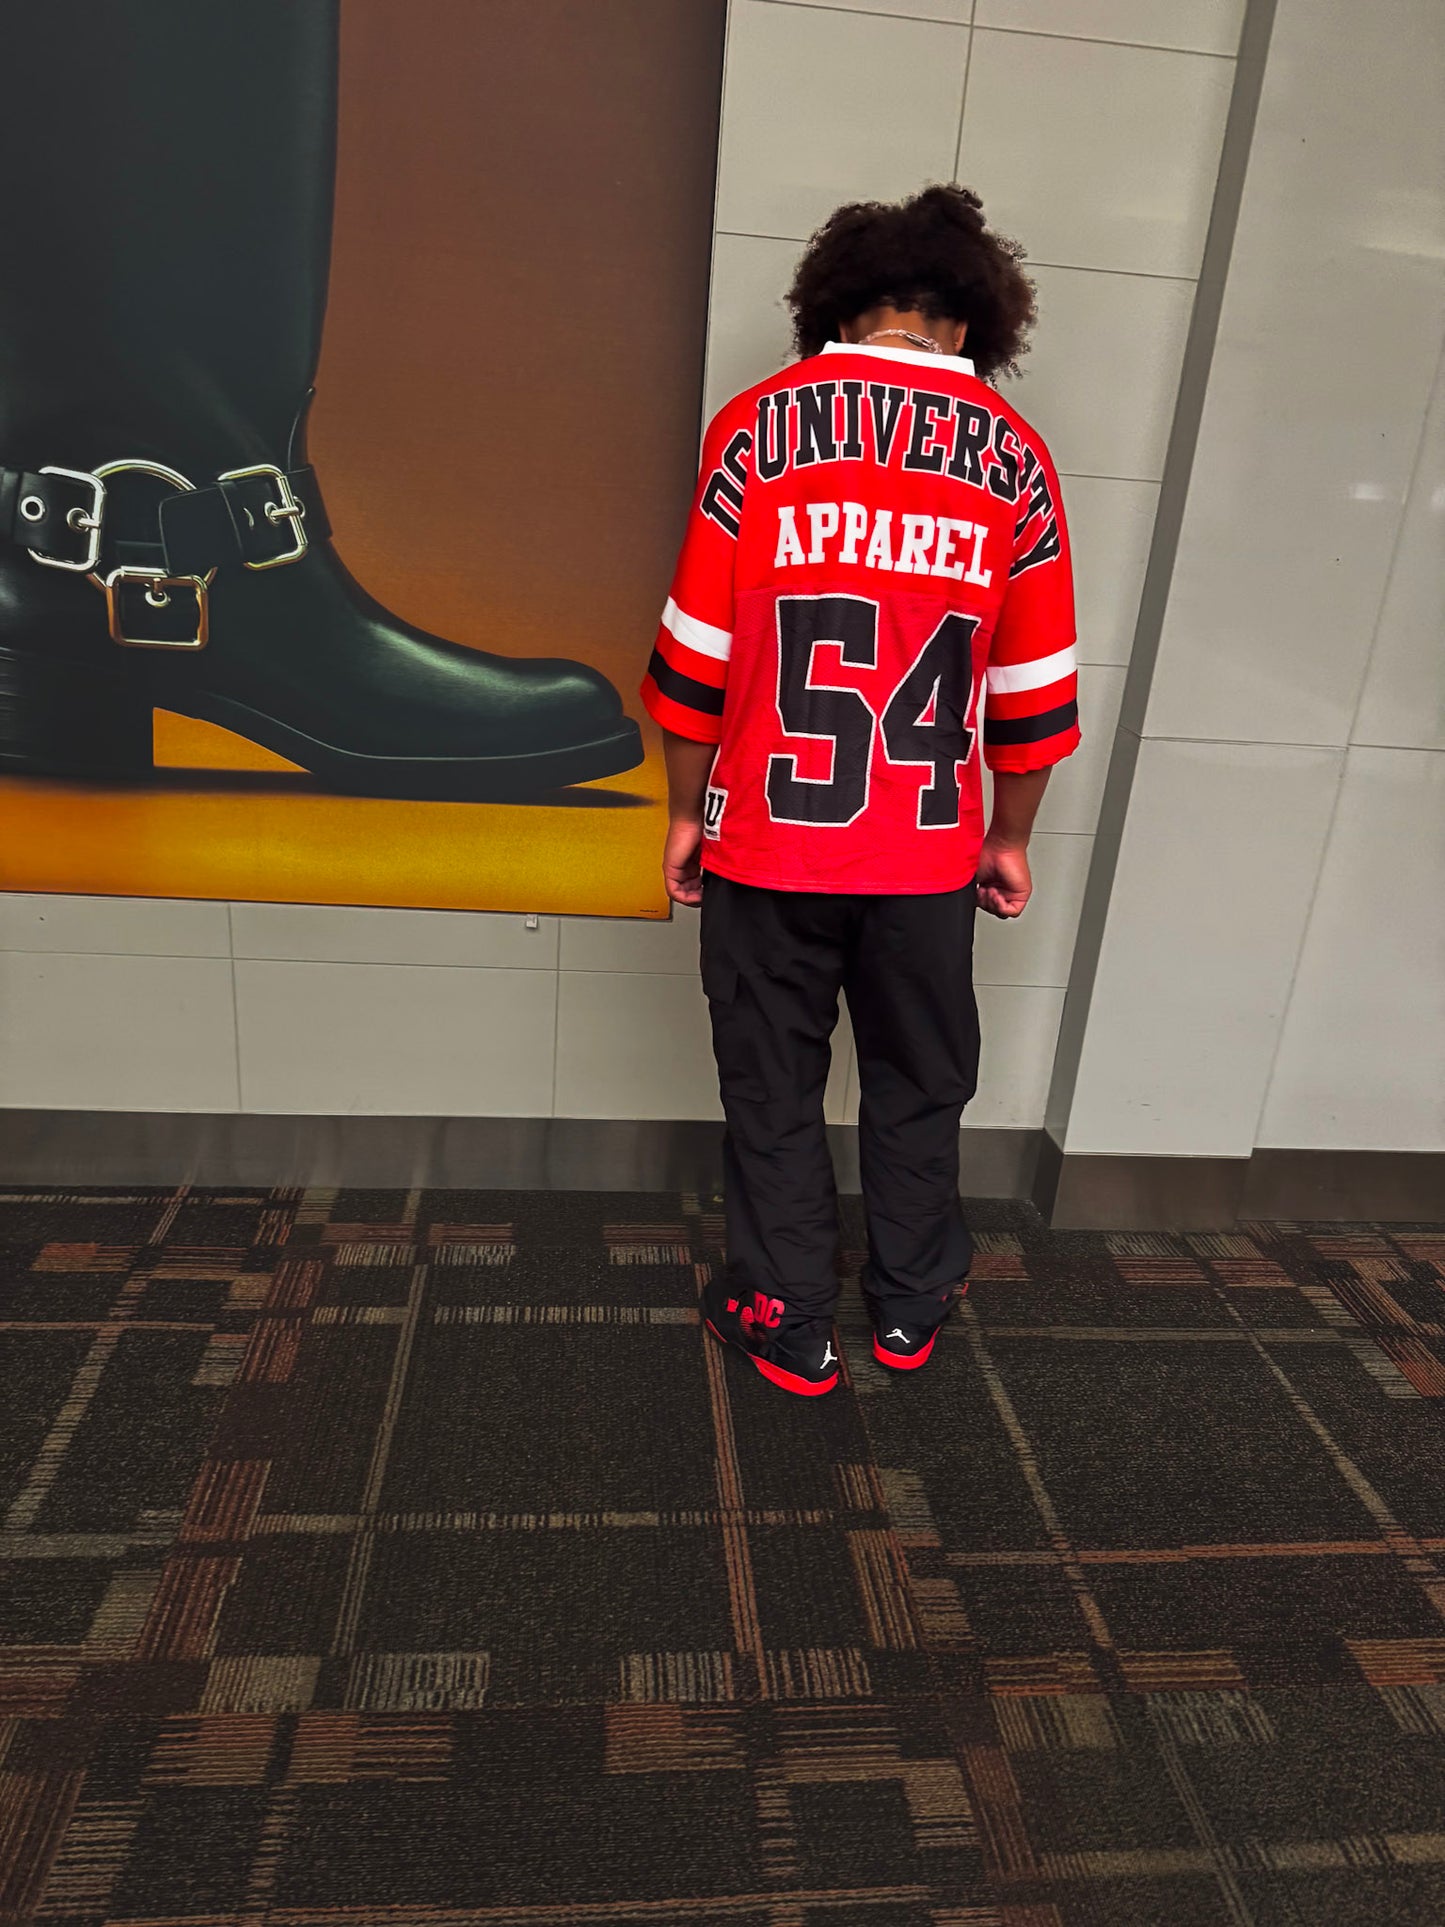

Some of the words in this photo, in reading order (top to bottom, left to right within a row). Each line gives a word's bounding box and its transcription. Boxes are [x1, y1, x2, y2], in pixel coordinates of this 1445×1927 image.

[774, 501, 993, 588] APPAREL
[765, 592, 982, 830] 54
[706, 791, 725, 827] U
